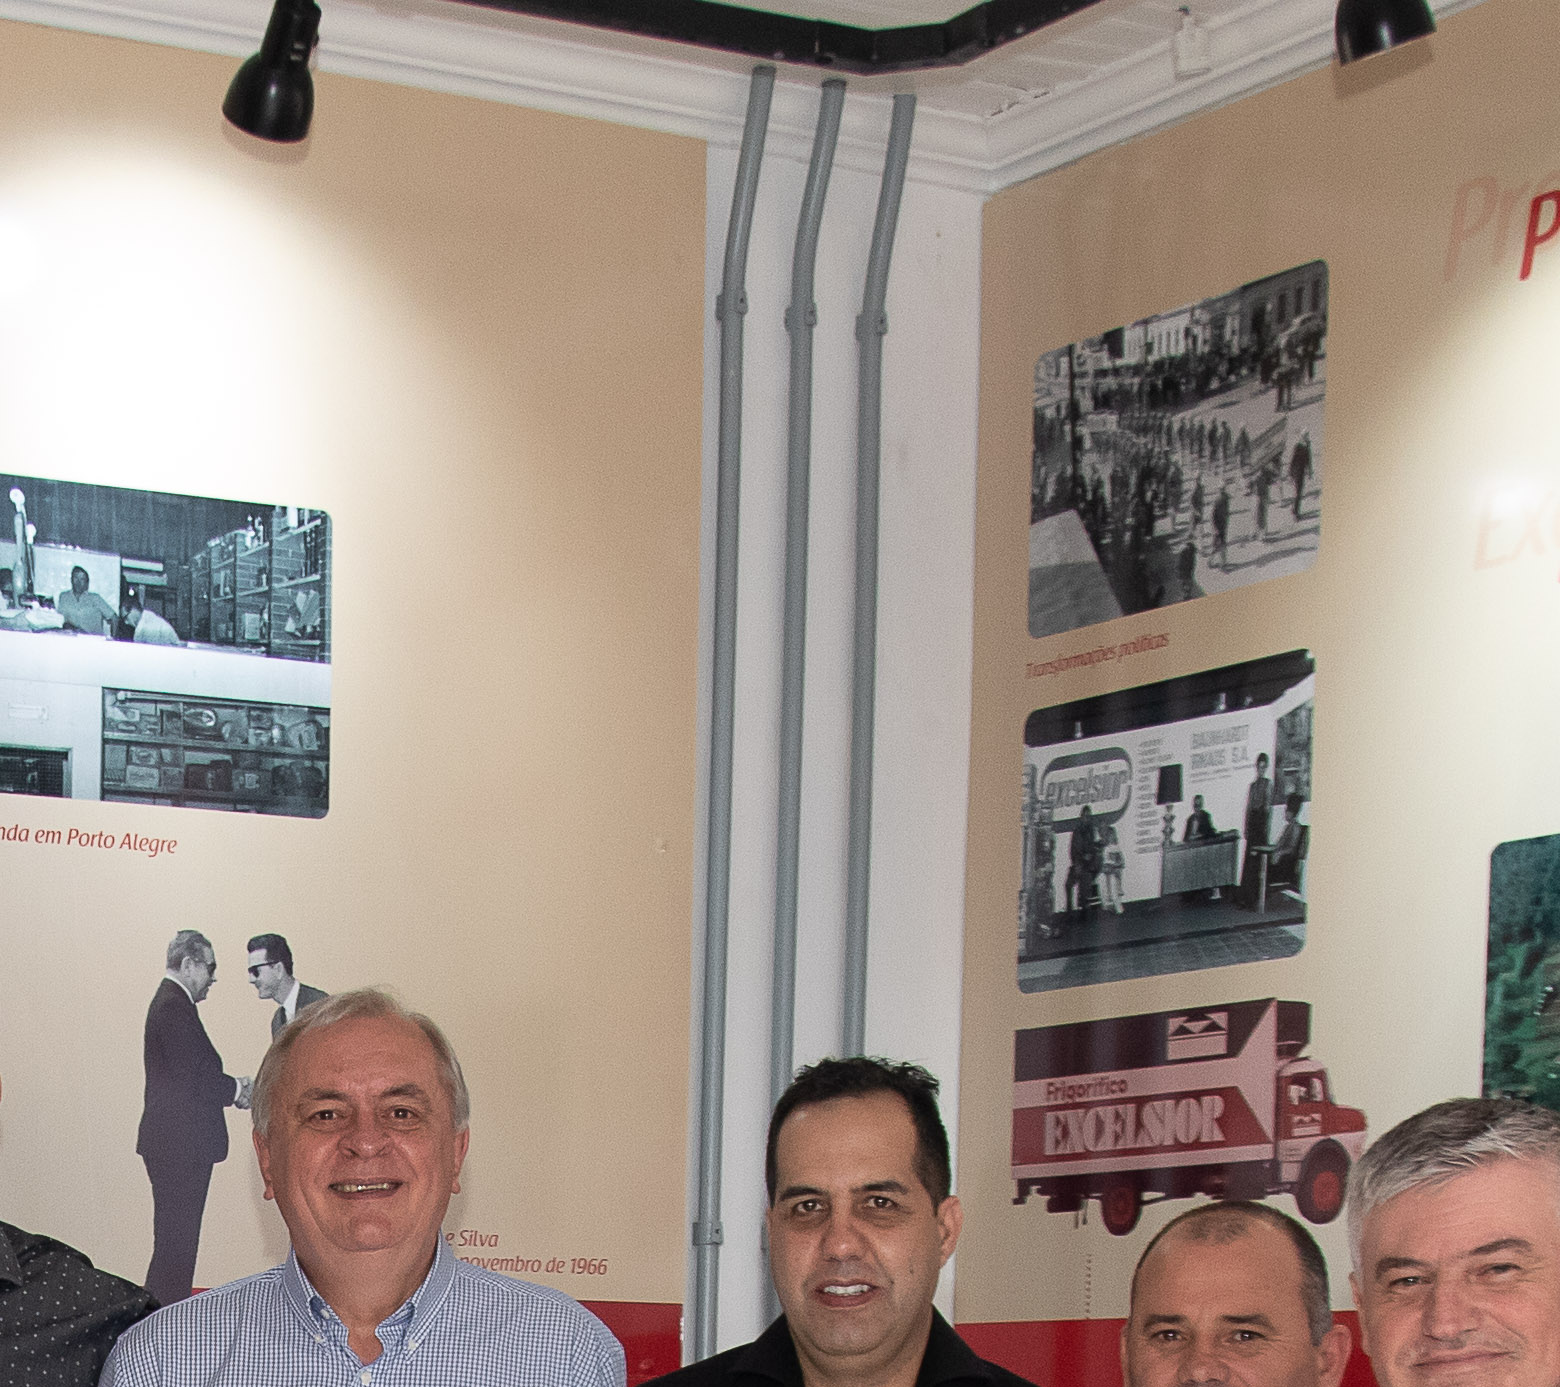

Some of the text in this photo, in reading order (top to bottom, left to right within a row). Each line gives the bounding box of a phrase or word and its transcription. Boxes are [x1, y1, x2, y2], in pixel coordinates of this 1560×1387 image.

[34, 830, 61, 845] em
[67, 828, 115, 849] Porto
[119, 831, 177, 858] Alegre
[1044, 1095, 1226, 1156] EXCELSIOR
[458, 1230, 499, 1247] Silva
[545, 1257, 566, 1274] de
[570, 1258, 609, 1275] 1966
